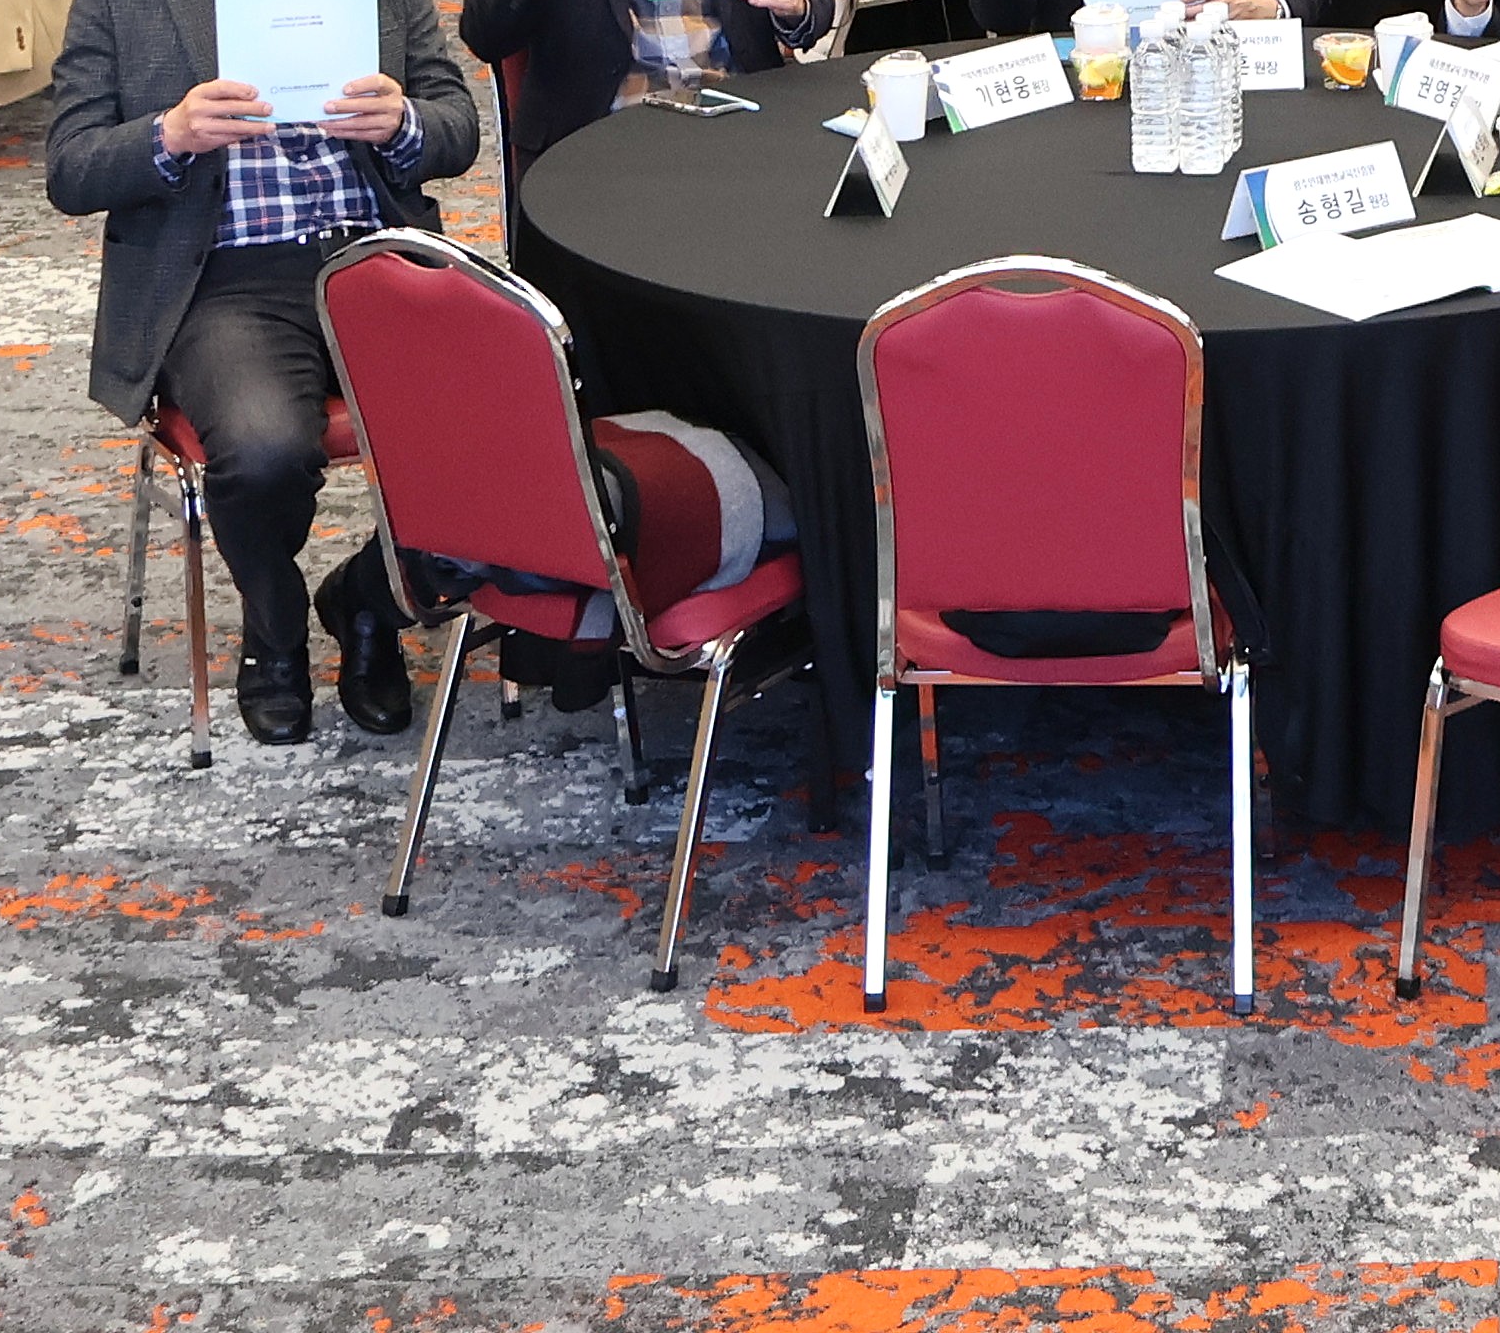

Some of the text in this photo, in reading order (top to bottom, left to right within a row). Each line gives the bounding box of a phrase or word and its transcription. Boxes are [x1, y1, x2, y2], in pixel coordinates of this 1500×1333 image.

[1254, 61, 1278, 75] 원장
[1297, 186, 1390, 226] 송형길 원장
